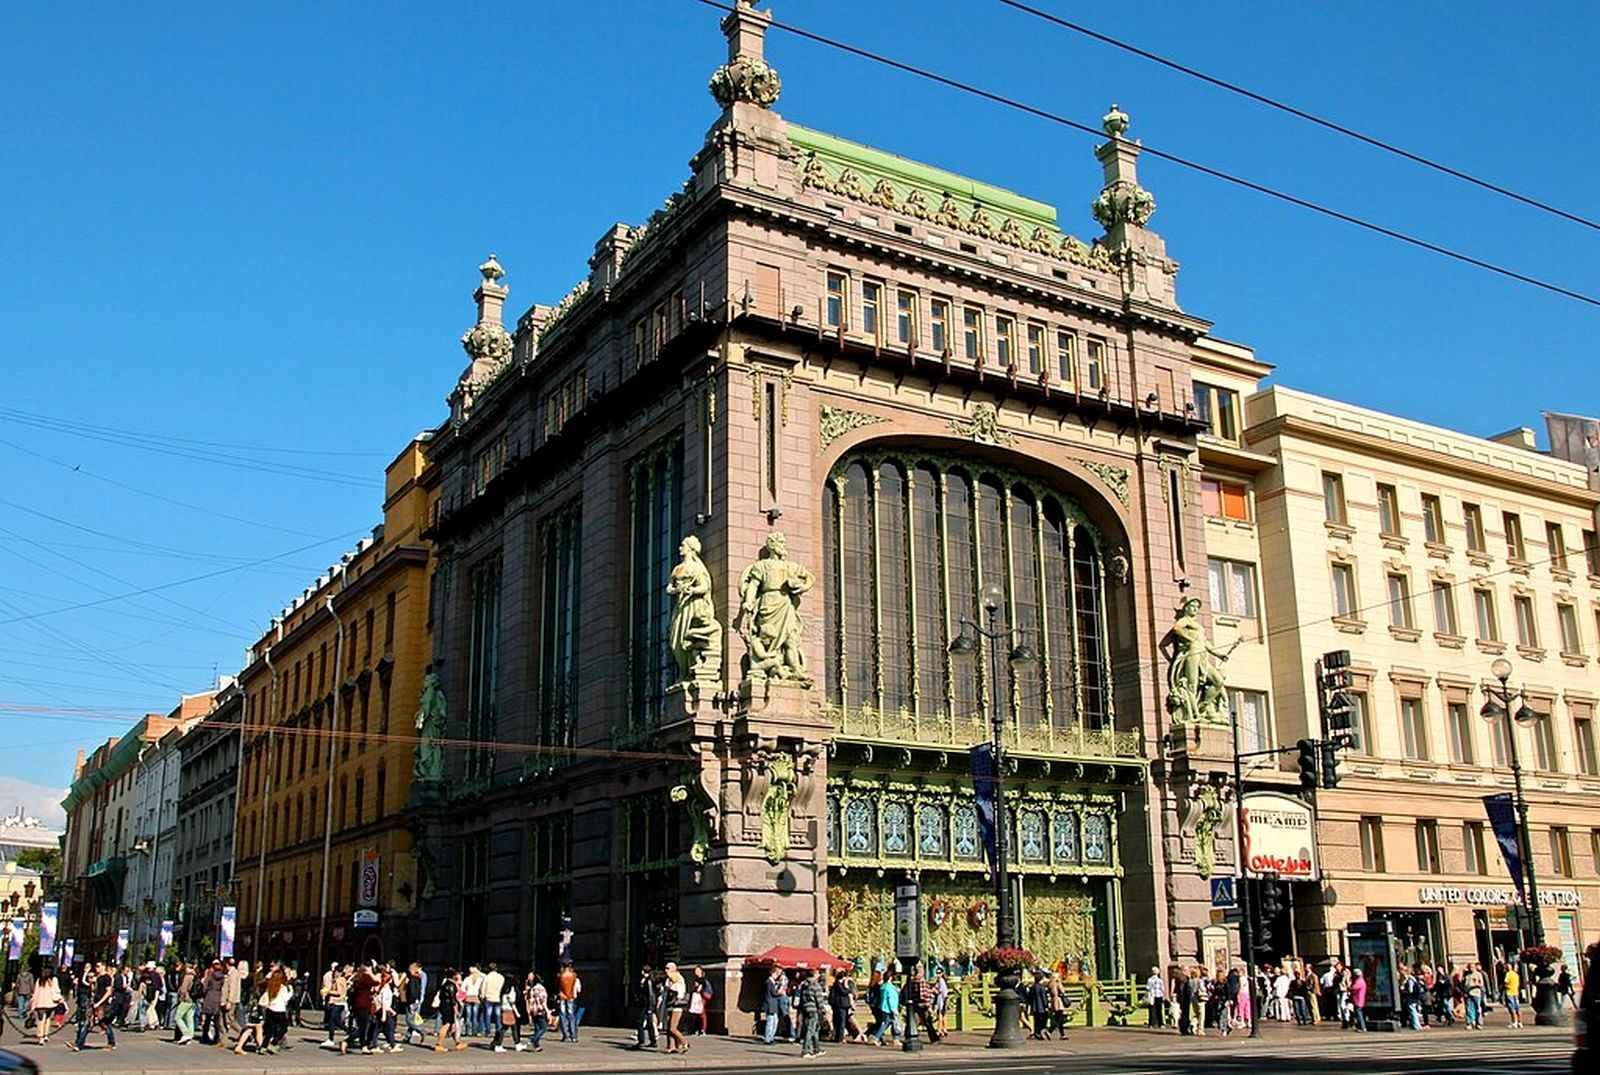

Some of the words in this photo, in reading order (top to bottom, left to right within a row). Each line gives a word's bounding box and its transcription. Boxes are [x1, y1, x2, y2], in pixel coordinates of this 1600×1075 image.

[1420, 888, 1462, 903] UNITED
[1466, 888, 1509, 905] COLORS
[1531, 890, 1582, 906] ENETTON
